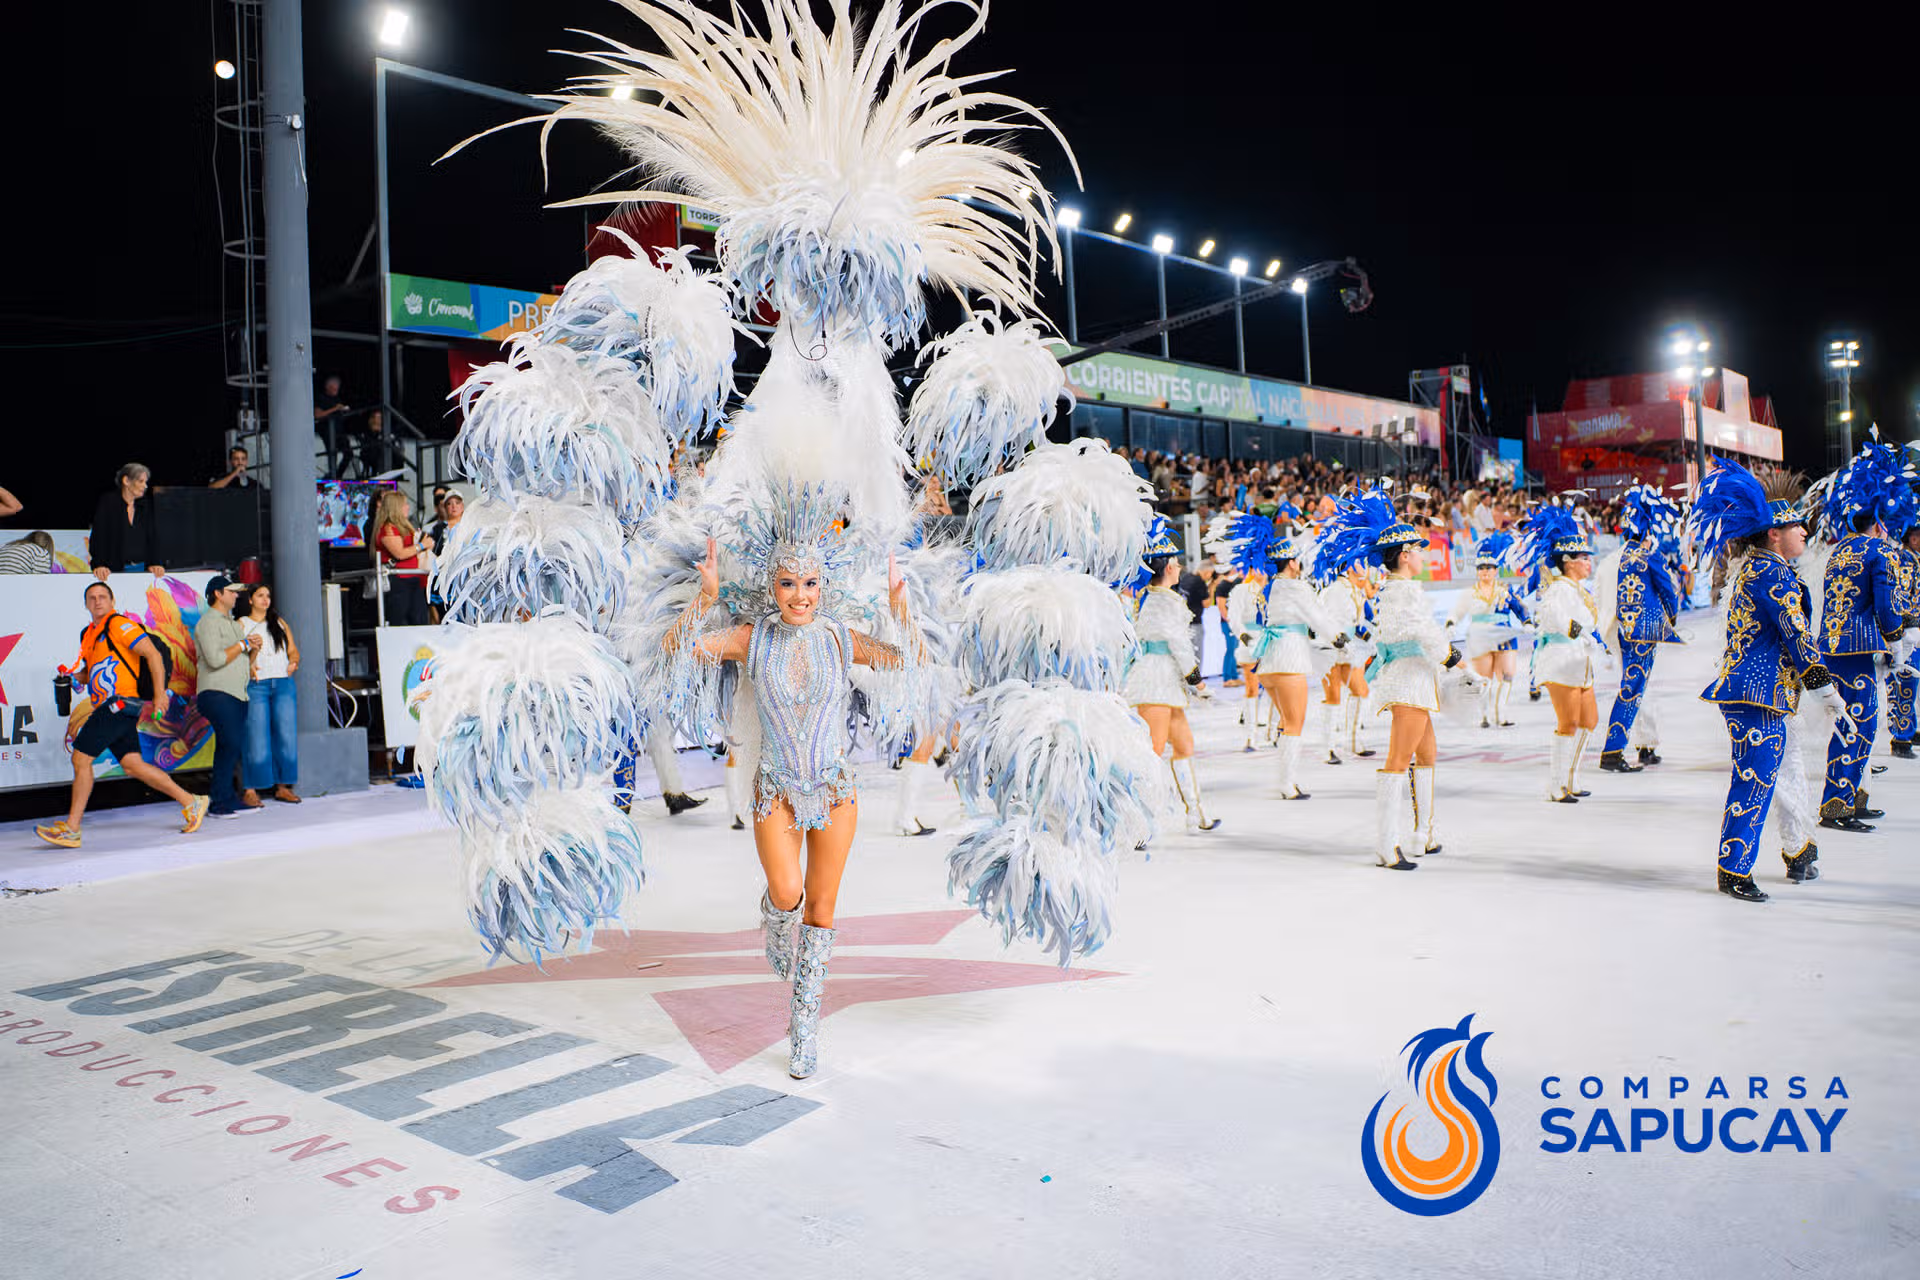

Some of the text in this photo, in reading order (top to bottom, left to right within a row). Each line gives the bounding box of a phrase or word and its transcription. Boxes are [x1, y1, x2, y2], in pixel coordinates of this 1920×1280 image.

[1066, 361, 1193, 403] CORRIENTES
[1196, 381, 1266, 415] CAPITAL
[1268, 393, 1341, 424] NACIONAL
[14, 949, 826, 1215] ESTRELLA
